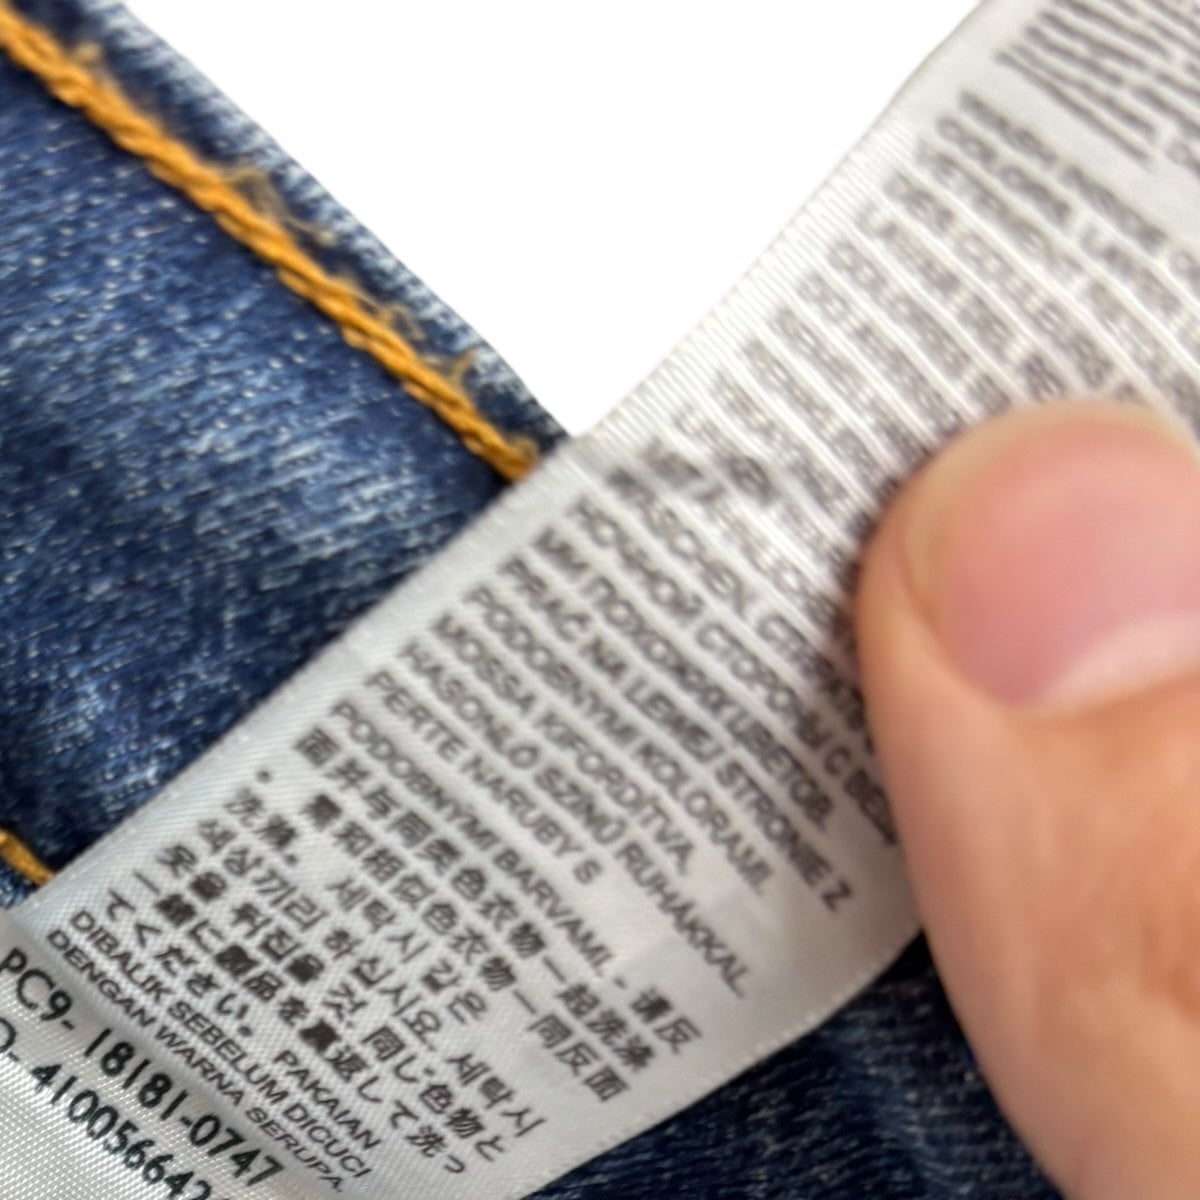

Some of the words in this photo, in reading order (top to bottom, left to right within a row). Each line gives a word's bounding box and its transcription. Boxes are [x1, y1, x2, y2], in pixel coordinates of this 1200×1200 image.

[363, 670, 468, 763] PERTE
[459, 754, 583, 858] NARUBY
[572, 857, 604, 886] S
[579, 636, 629, 681] NA
[620, 674, 725, 765] LEWEJ
[713, 758, 832, 888] STRONIE
[821, 880, 856, 914] Z
[105, 888, 254, 1038] てください。
[272, 1049, 382, 1151] PAKAIAN
[327, 876, 432, 964] 세탁시
[47, 928, 160, 1030] DENGAN
[154, 1025, 246, 1107] WARNA
[245, 1105, 344, 1194] SERUPA.
[69, 909, 173, 1003] DIBALIK
[167, 1000, 290, 1104] SEBELUM
[282, 1102, 373, 1180] DICUCI
[84, 1026, 286, 1188] 18181-0747
[446, 1051, 548, 1138] 세탁시
